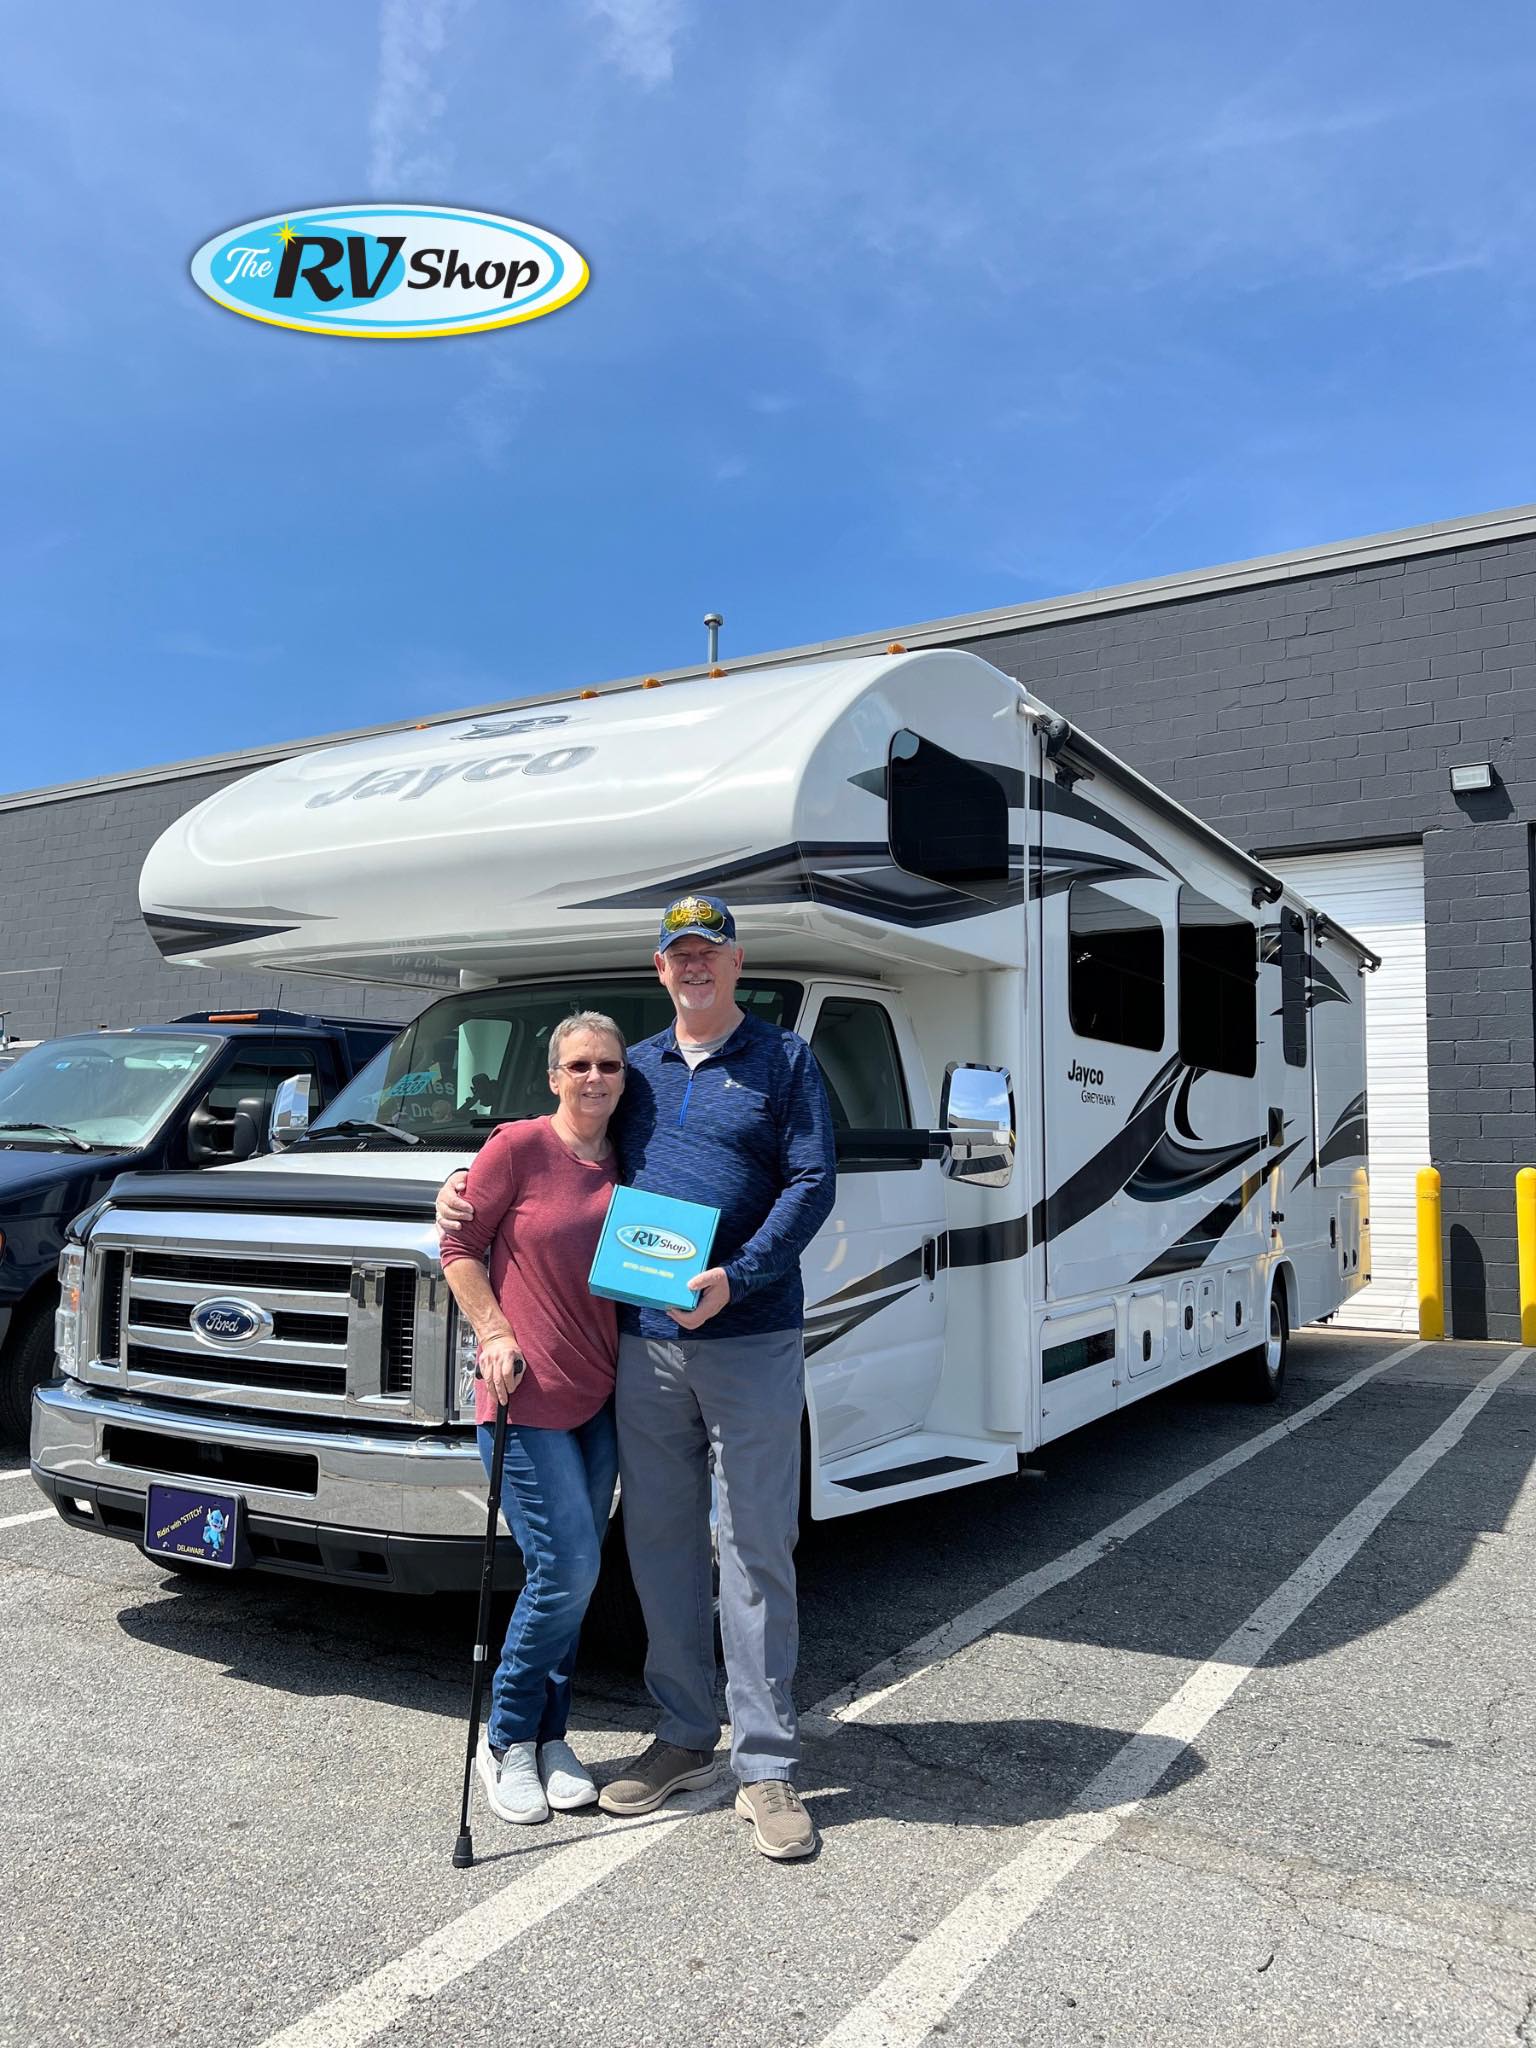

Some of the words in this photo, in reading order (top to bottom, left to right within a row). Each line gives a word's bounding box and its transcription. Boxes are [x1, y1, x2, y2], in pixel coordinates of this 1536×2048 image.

[304, 746, 598, 809] Jayco
[1068, 1060, 1103, 1087] Jayco
[632, 1231, 660, 1246] RV
[660, 1239, 686, 1253] Shop
[205, 1310, 241, 1333] Ford
[177, 1544, 204, 1555] DELAWARE
